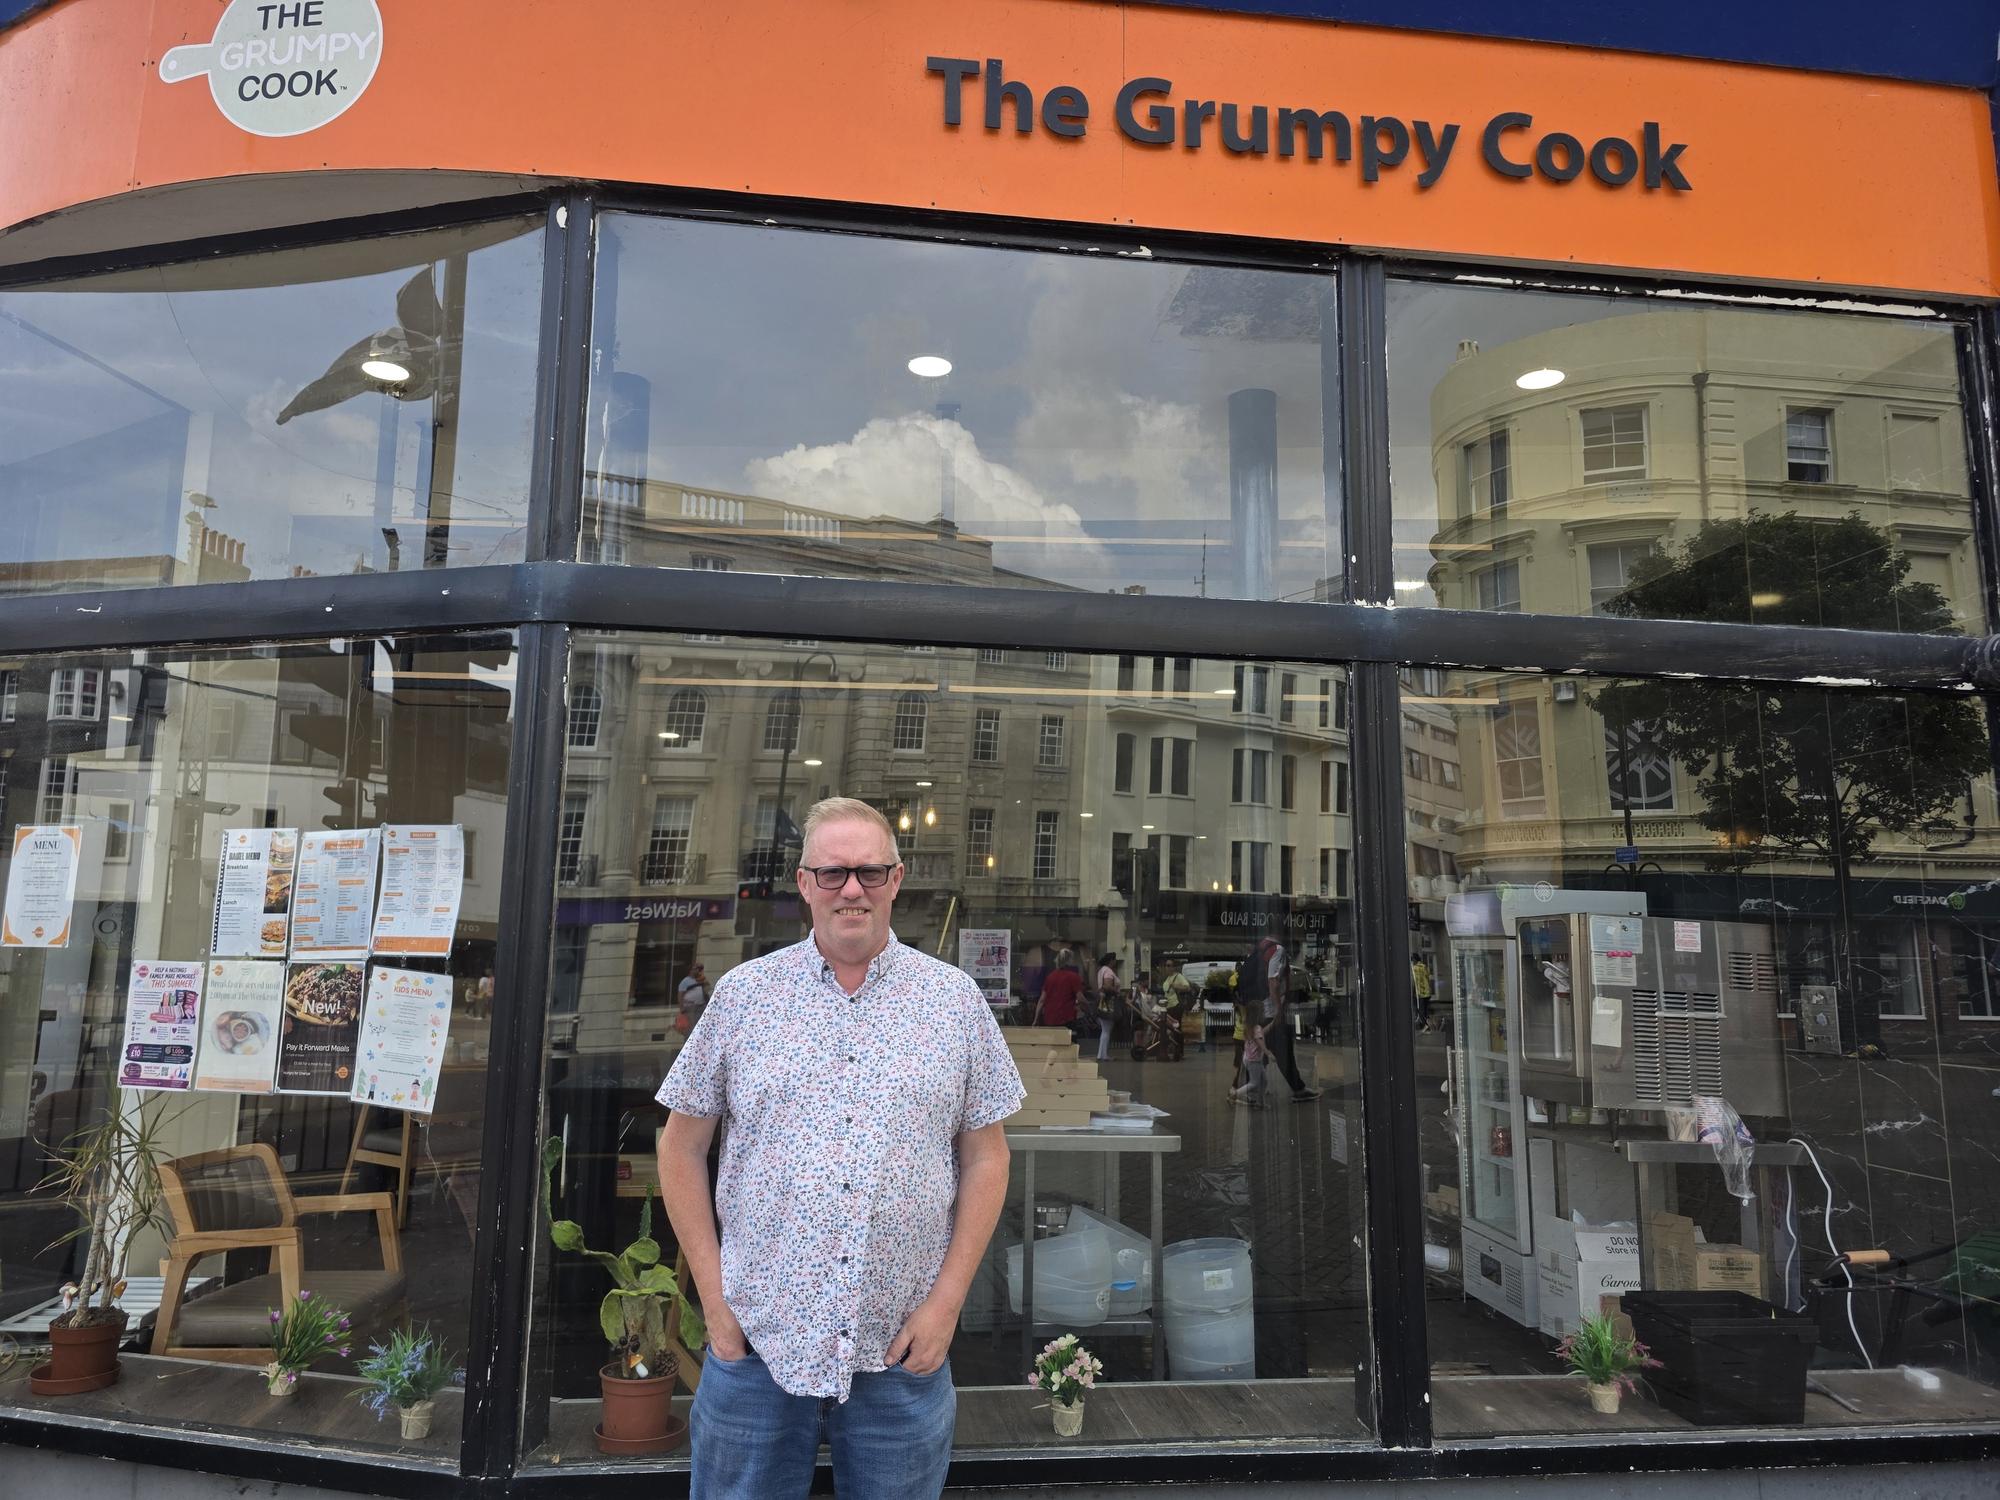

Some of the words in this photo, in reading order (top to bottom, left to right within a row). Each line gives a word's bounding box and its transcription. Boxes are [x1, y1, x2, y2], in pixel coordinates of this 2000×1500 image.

[257, 1, 324, 31] THE
[219, 31, 377, 71] GRUMPY
[238, 68, 338, 102] COOK
[926, 56, 1089, 138] The
[1115, 76, 1460, 189] Grumpy
[1482, 111, 1693, 191] Cook
[33, 840, 60, 850] MENU
[152, 979, 166, 988] THIS
[167, 979, 196, 988] SUMMER!
[394, 985, 410, 994] KIDS
[410, 987, 433, 997] MENU
[304, 999, 341, 1014] New!
[286, 1043, 298, 1052] Pay
[303, 1043, 330, 1052] Forward
[130, 1049, 141, 1058] £10
[1610, 1236, 1624, 1246] DO
[1605, 1246, 1629, 1255] Store
